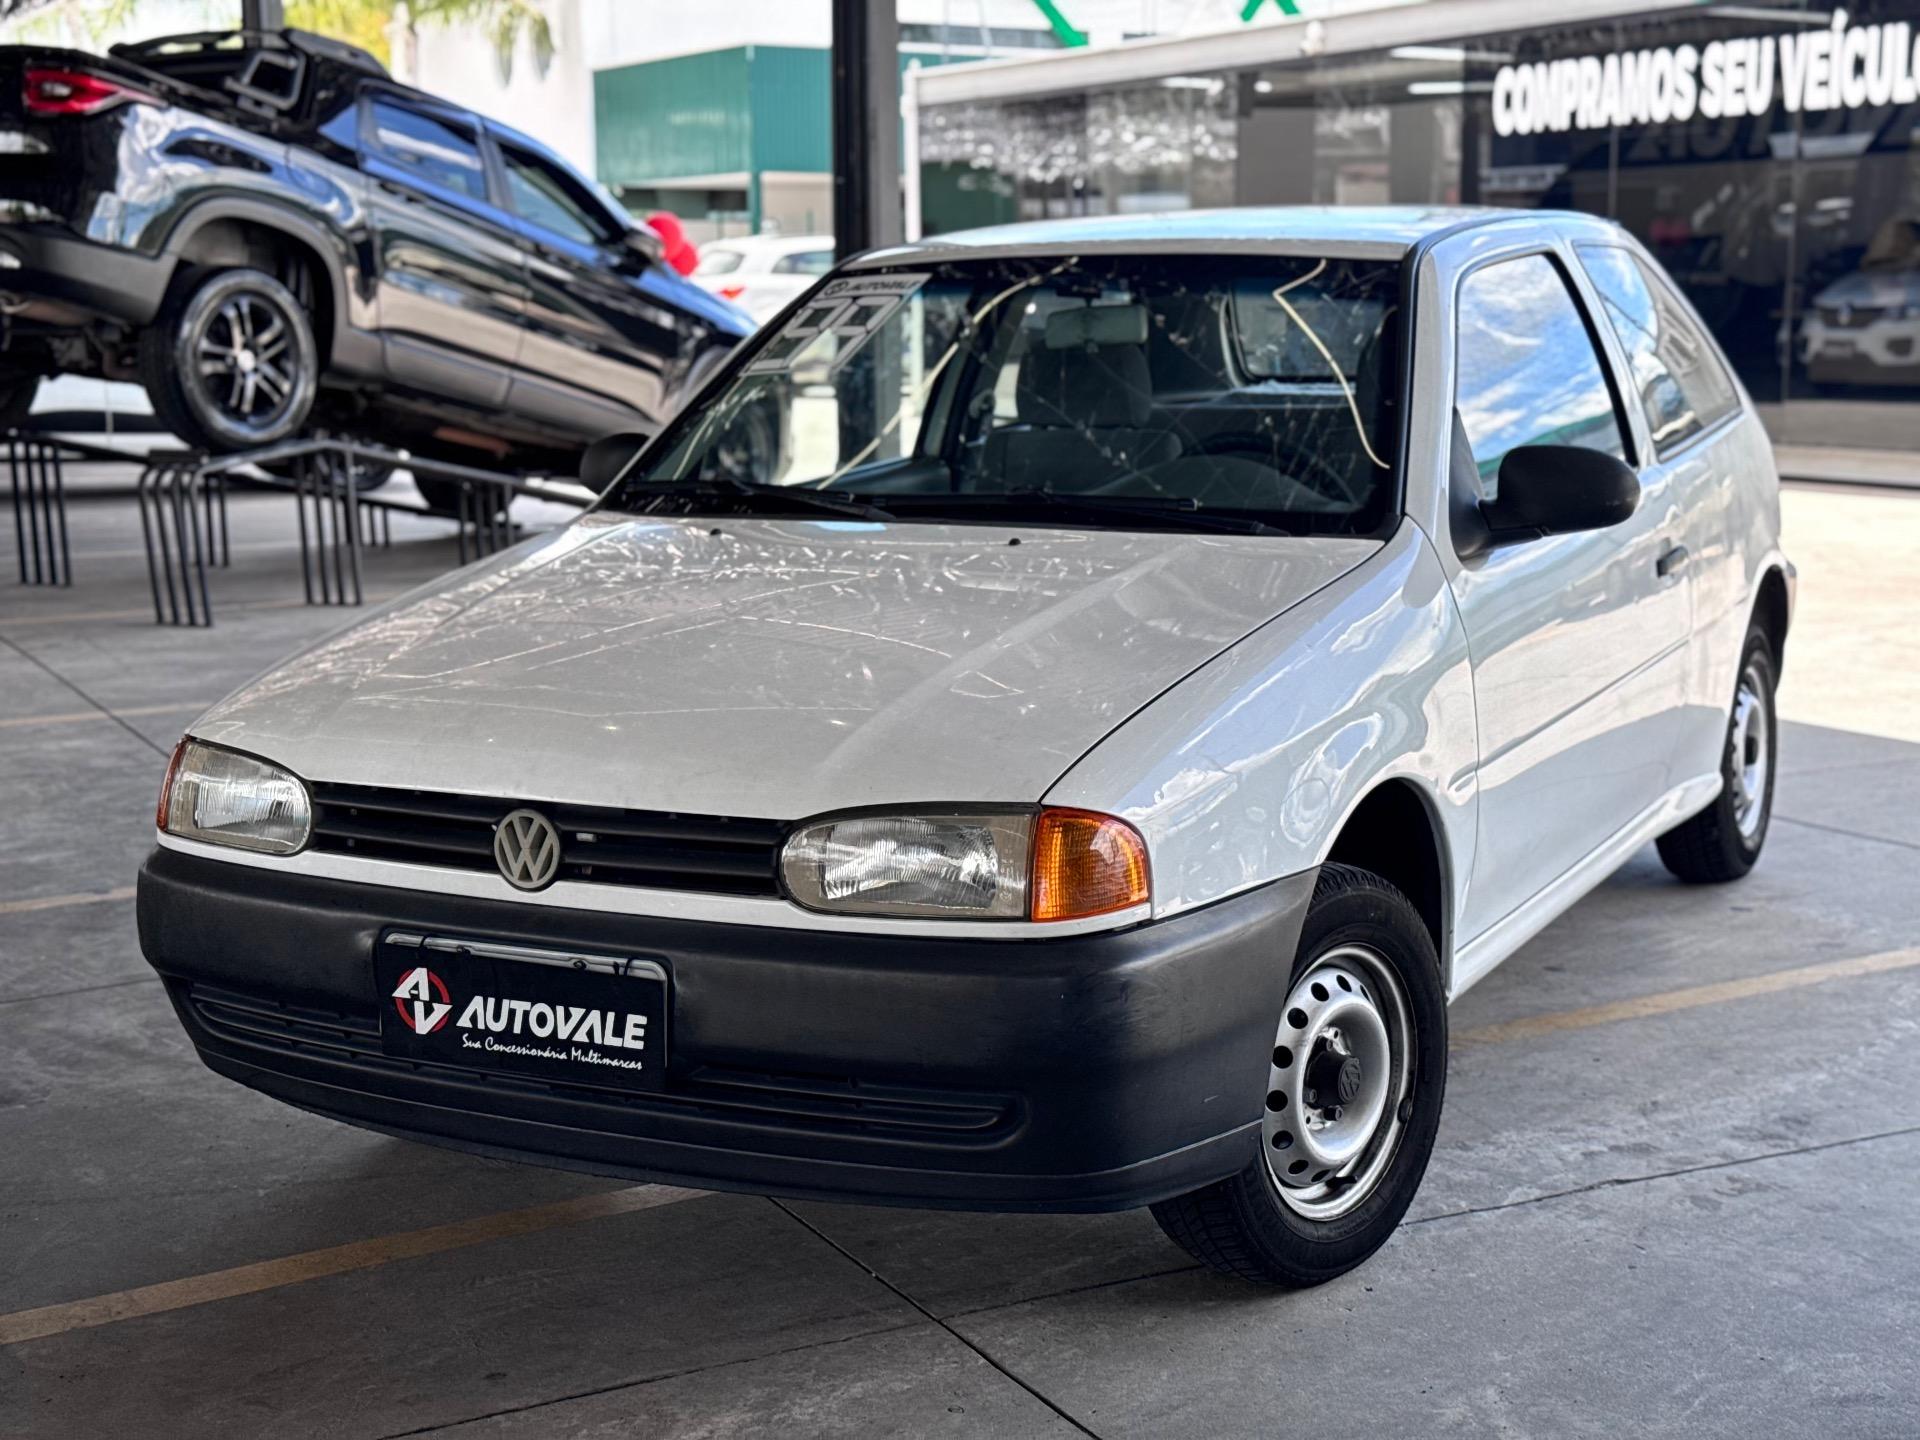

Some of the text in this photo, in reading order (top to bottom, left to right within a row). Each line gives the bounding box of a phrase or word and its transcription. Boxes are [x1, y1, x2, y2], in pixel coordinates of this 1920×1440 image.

[1492, 44, 1698, 137] COMPRAMOS
[1700, 36, 1775, 119] SEU
[494, 808, 560, 889] VW
[391, 967, 453, 1035] AV
[456, 995, 648, 1050] AUTOVALE
[462, 1033, 643, 1070] Sua Concessionária Multimarcas
